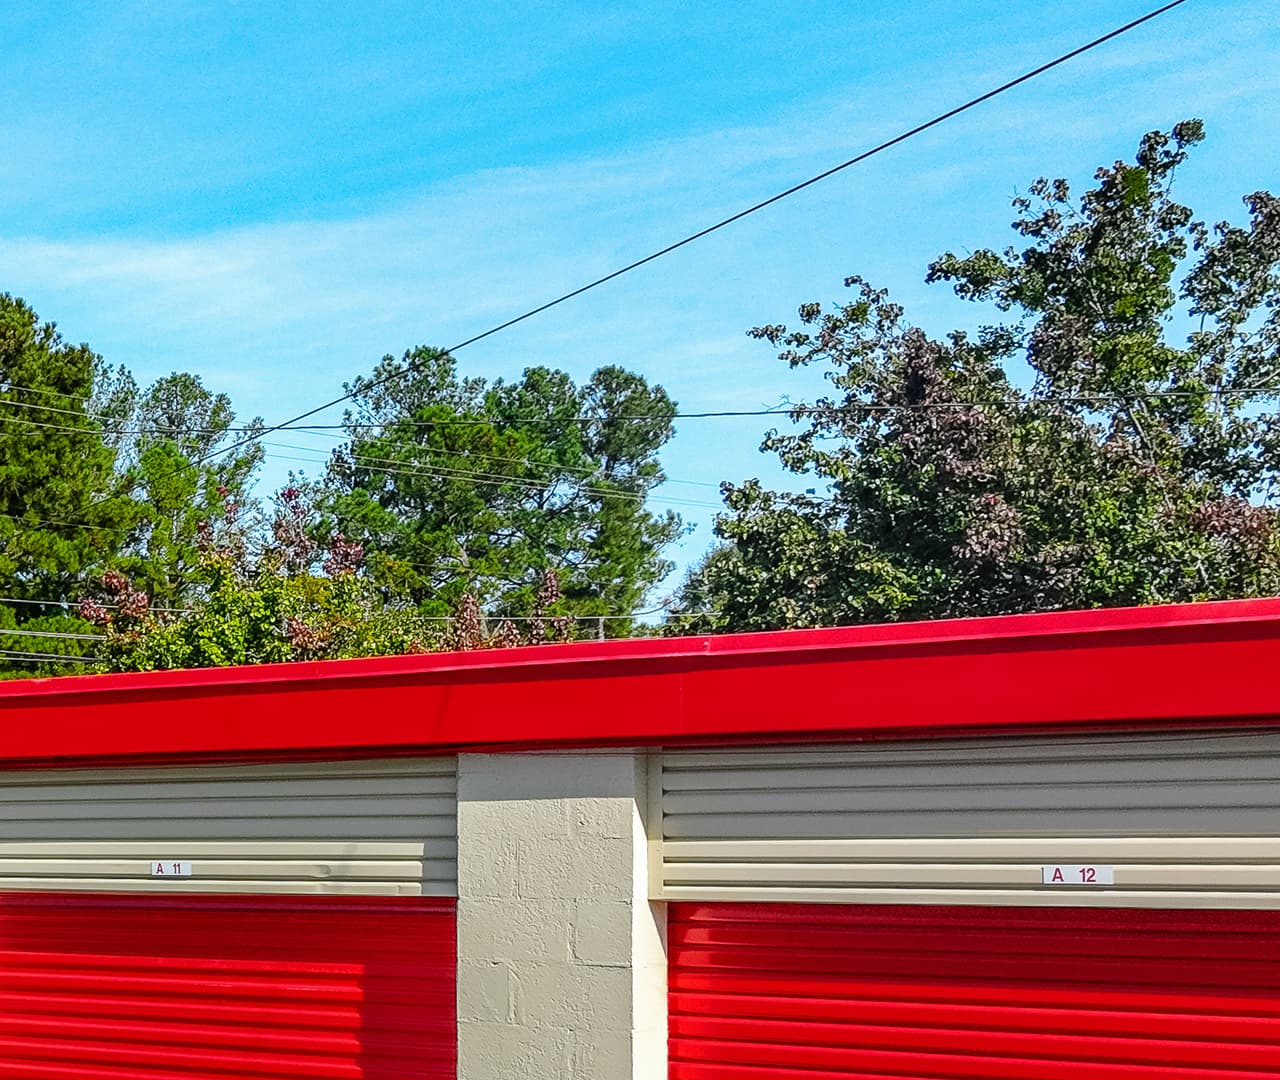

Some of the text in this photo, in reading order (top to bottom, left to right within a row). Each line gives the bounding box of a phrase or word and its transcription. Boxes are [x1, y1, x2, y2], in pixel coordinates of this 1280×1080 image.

[156, 862, 181, 874] A 11
[1051, 867, 1096, 882] A 12
